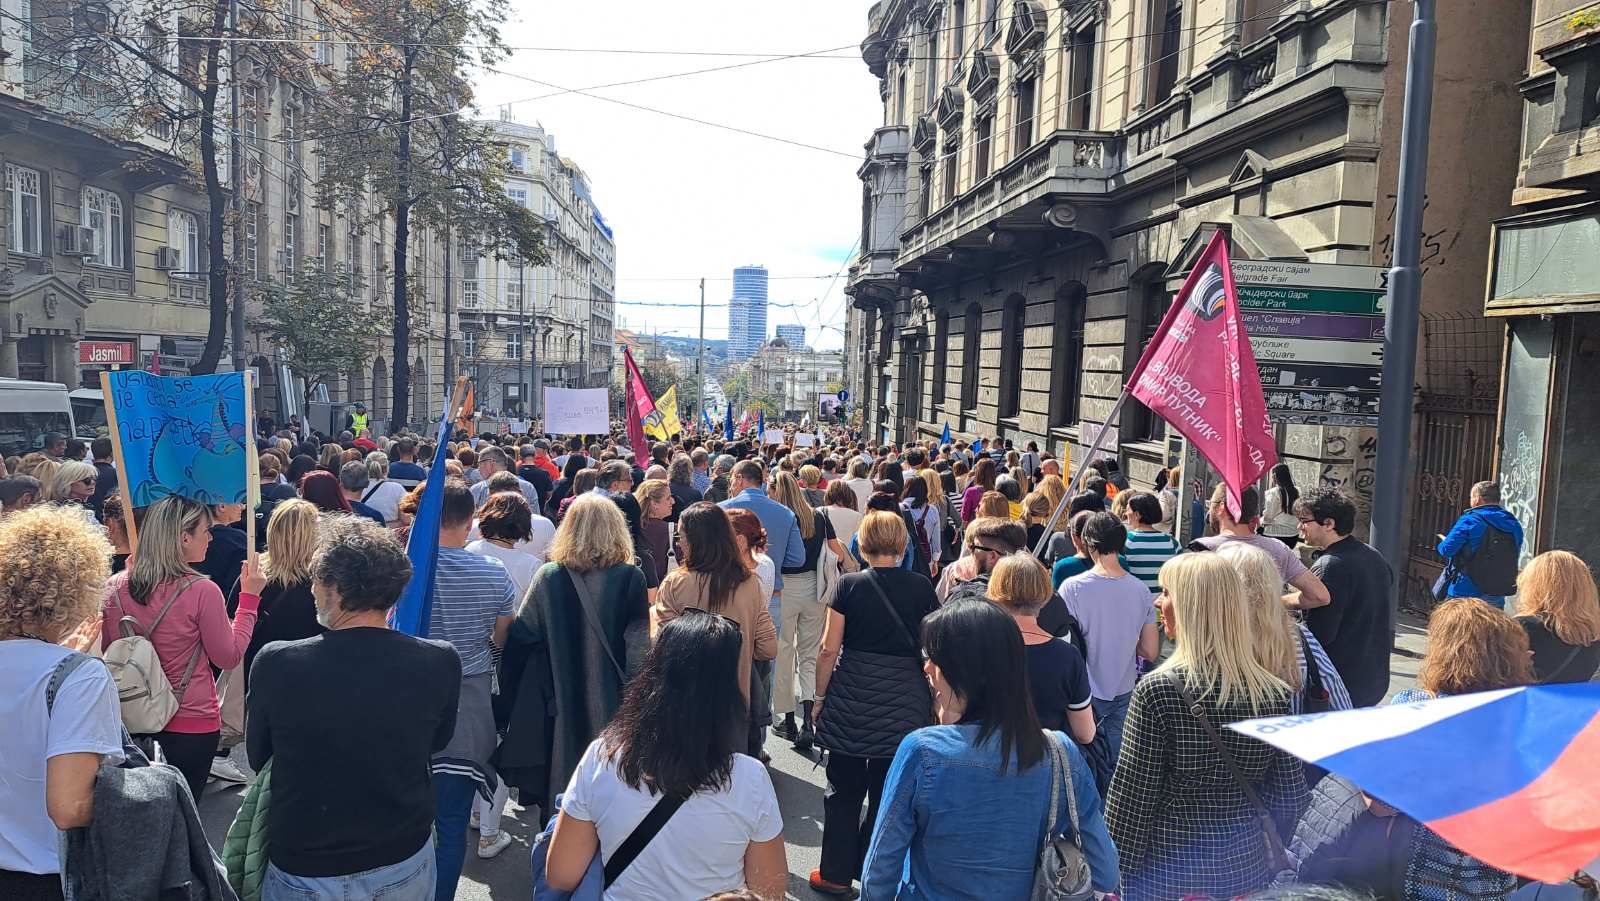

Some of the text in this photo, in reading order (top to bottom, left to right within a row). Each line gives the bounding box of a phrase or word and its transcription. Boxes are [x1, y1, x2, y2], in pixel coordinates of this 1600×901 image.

[1285, 264, 1310, 275] сајам
[1270, 274, 1288, 283] Fair
[1266, 299, 1287, 309] Park
[1255, 324, 1279, 334] Hotel
[1250, 337, 1290, 349] публике
[89, 344, 122, 361] Jasmil
[1264, 349, 1296, 360] Square
[115, 389, 135, 411] je
